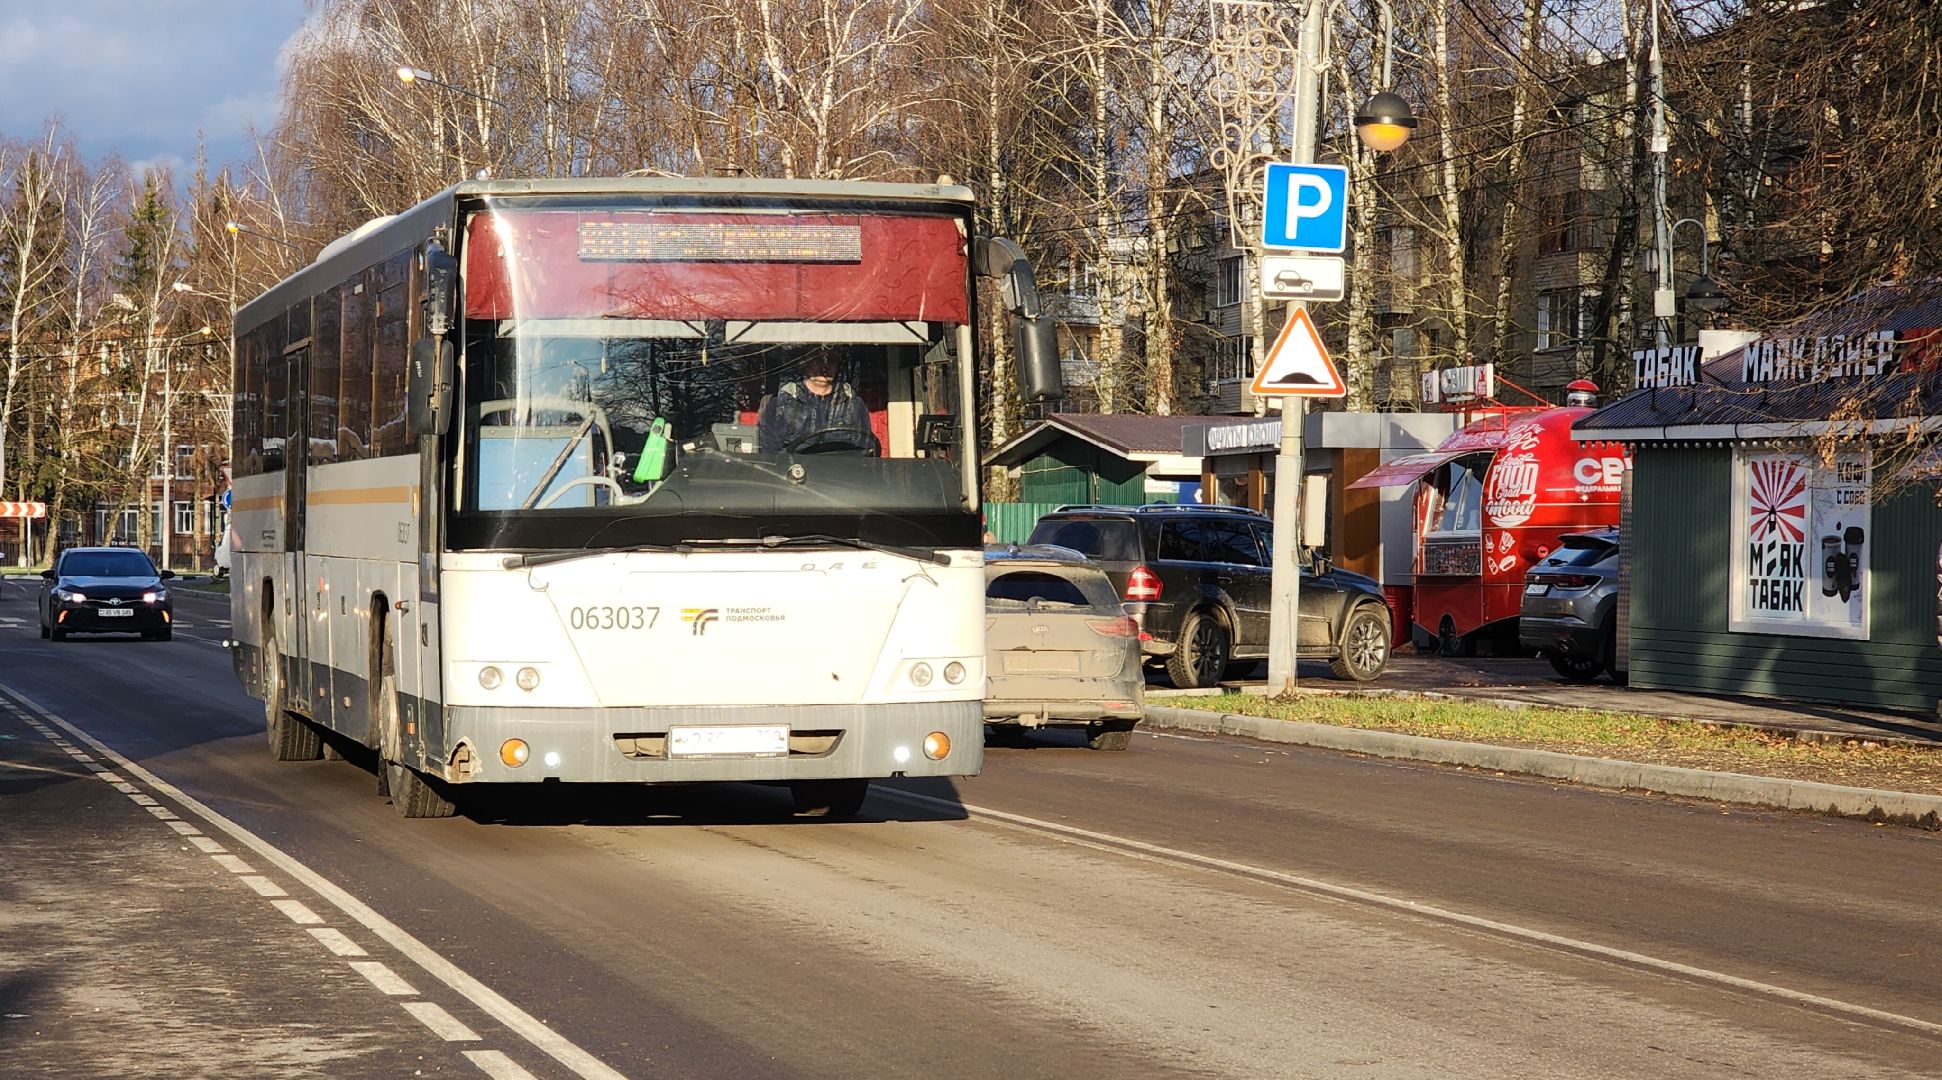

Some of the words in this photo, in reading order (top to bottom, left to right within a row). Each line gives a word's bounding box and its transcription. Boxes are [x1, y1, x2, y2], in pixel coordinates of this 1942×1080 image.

[1285, 173, 1333, 240] P
[1632, 346, 1698, 389] ТАБАК
[1742, 336, 1806, 383] МАЯК
[1811, 330, 1895, 383] ДОНЕР
[1208, 425, 1248, 450] ФРУКТЫ
[1248, 421, 1282, 448] ОВОЩ
[1488, 464, 1539, 500] FOOD
[1750, 579, 1804, 612] ТАБАК
[570, 606, 660, 630] 063037
[726, 614, 785, 622] ПОДМОСКОВЬЯ
